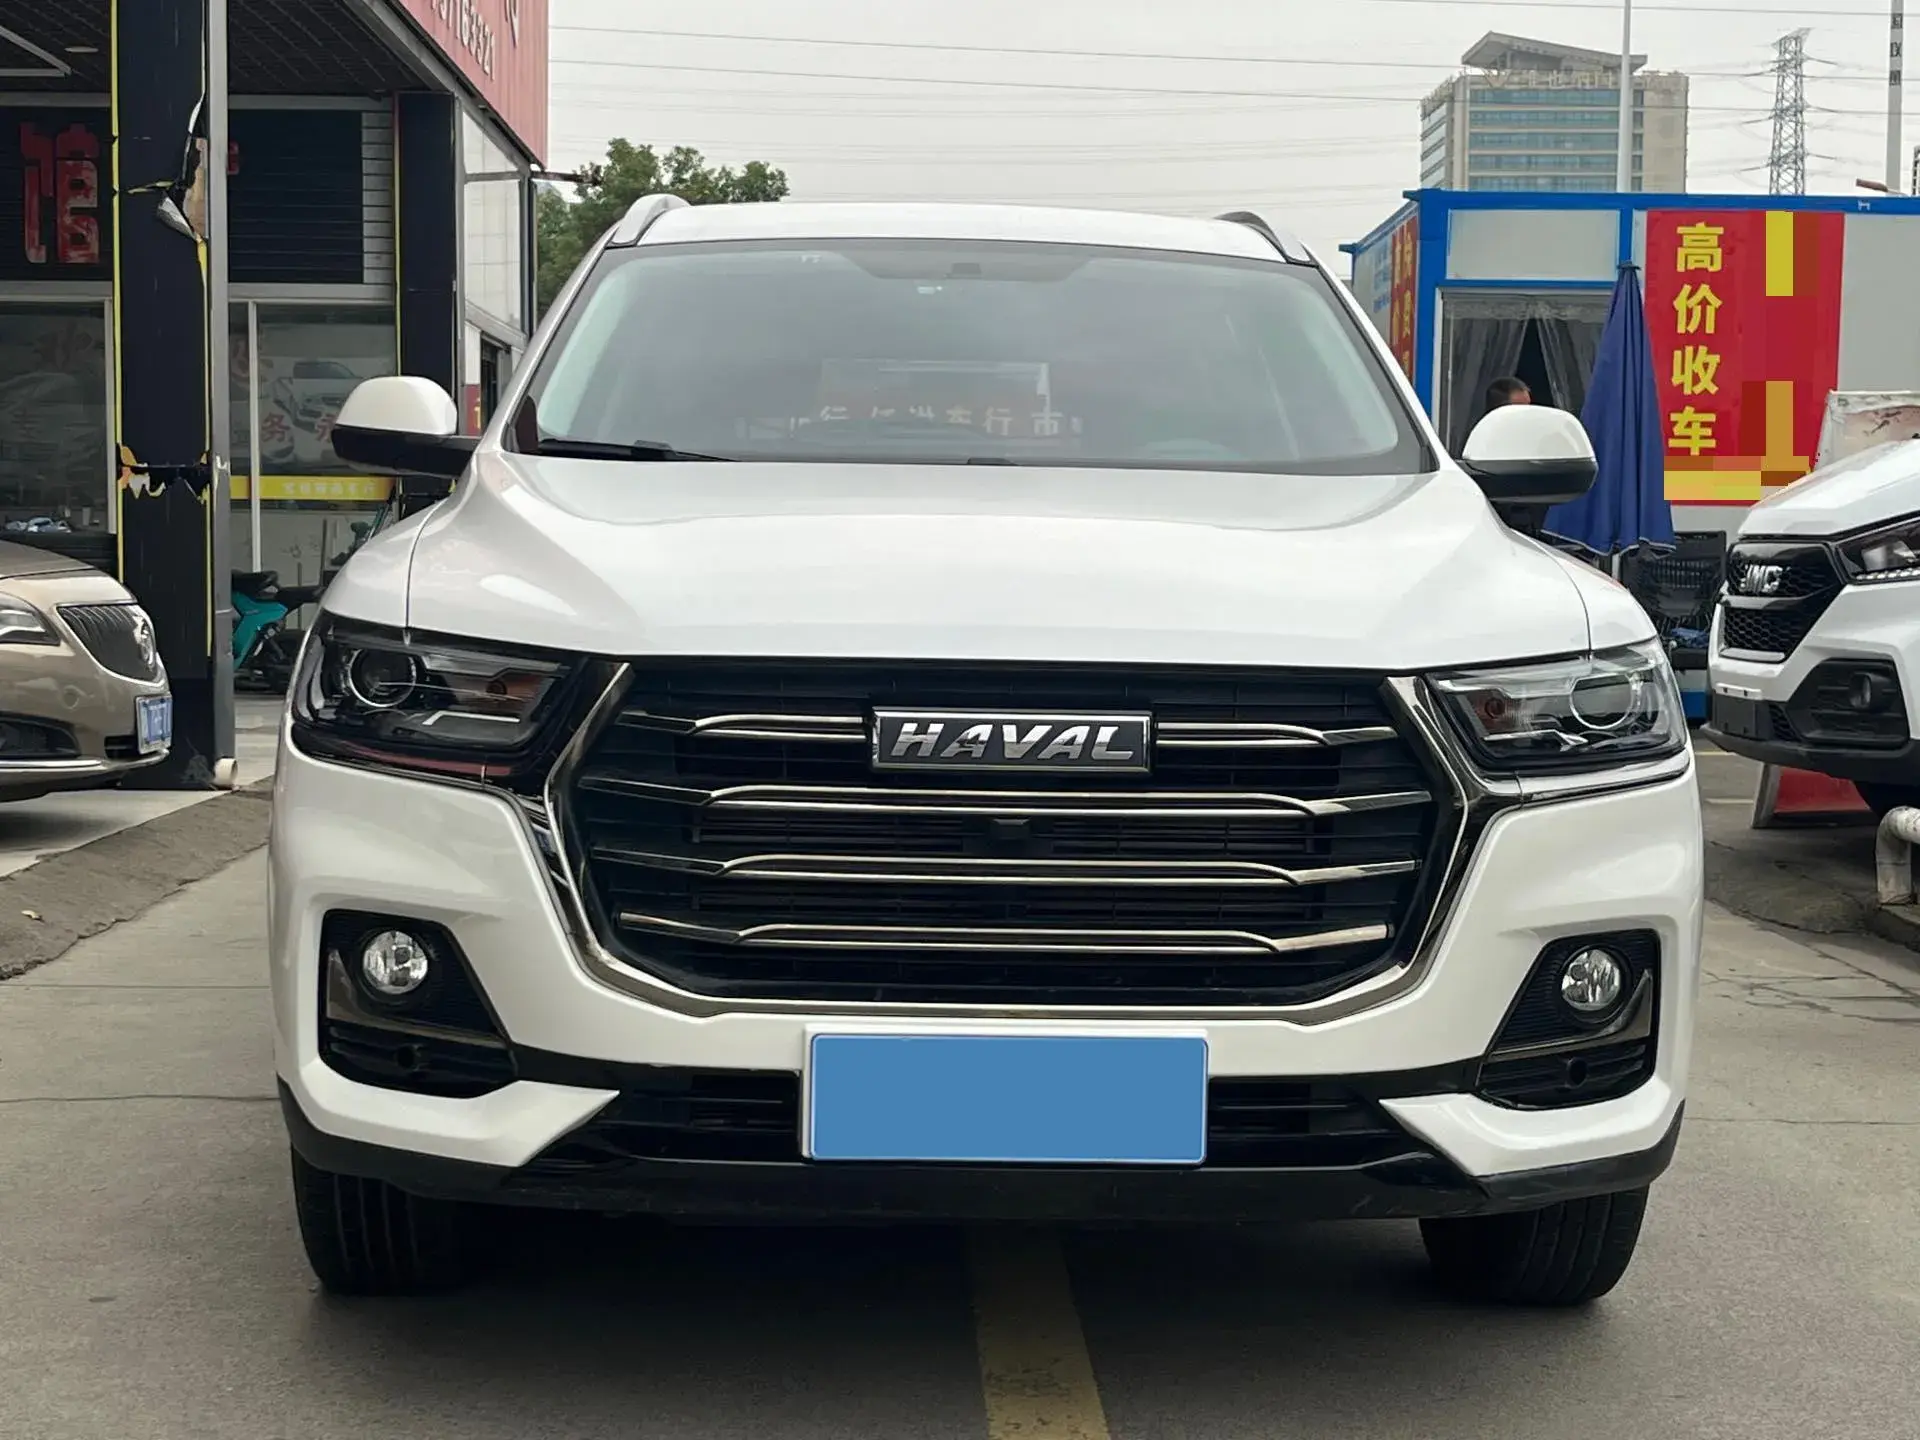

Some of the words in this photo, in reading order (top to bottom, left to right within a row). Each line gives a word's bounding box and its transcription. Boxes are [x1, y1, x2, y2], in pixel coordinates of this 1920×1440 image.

[1668, 222, 1724, 456] 高价收车
[891, 722, 1134, 760] HAVAL
